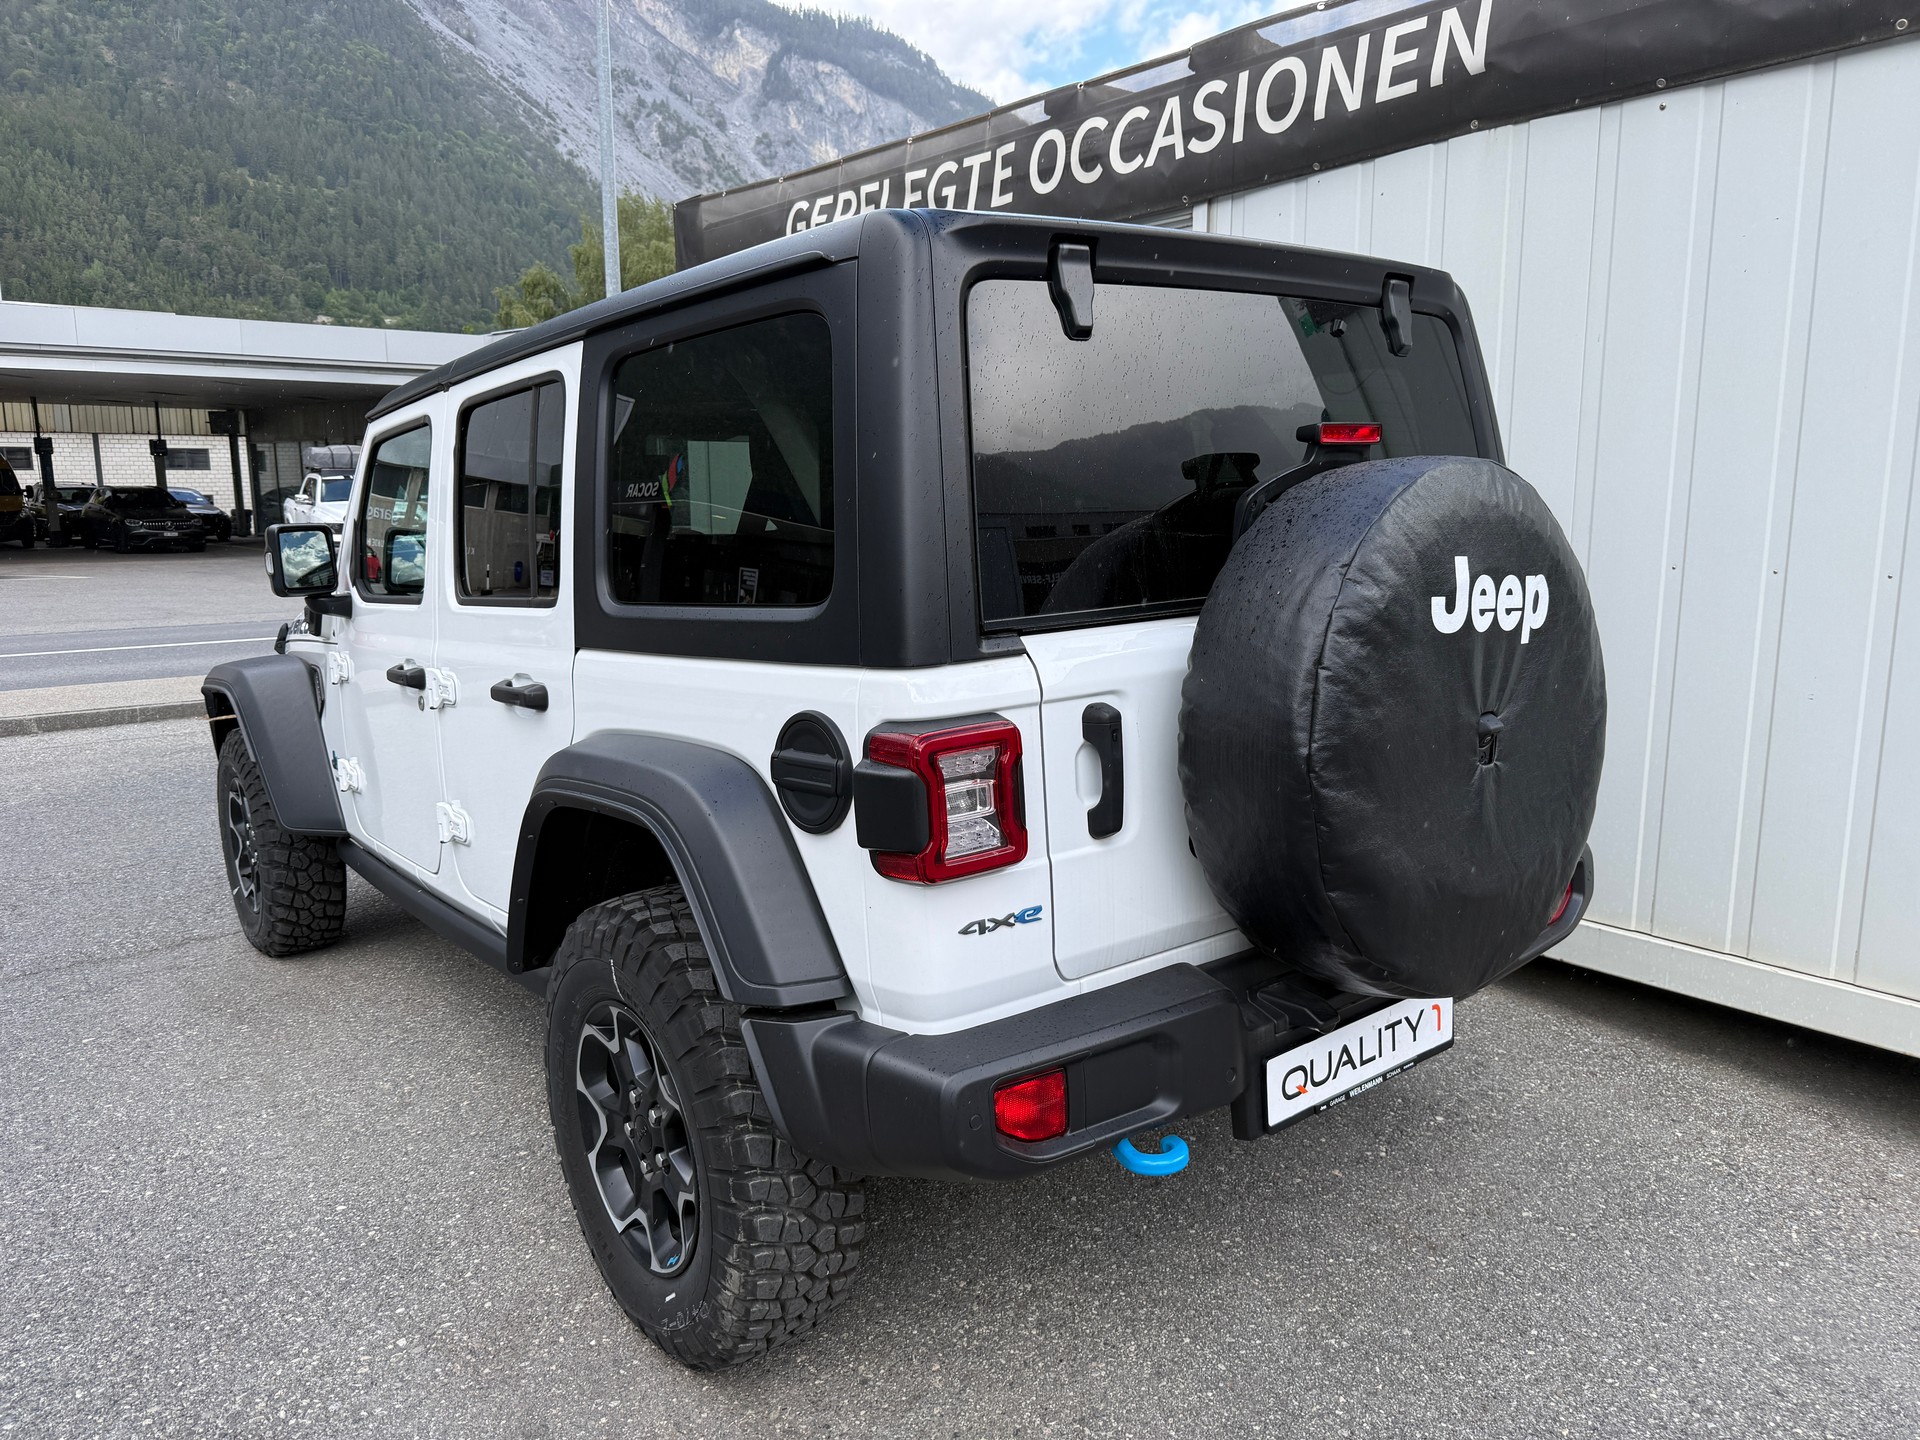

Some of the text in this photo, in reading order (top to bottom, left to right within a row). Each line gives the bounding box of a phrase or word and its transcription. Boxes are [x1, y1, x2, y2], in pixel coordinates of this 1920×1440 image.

[1028, 0, 1493, 196] OCCASIONEN
[1430, 555, 1550, 645] Jeep
[1281, 1003, 1441, 1101] QUALITY 1
[1329, 1095, 1346, 1107] GARAGE
[1349, 1076, 1384, 1098] WEILENMANN
